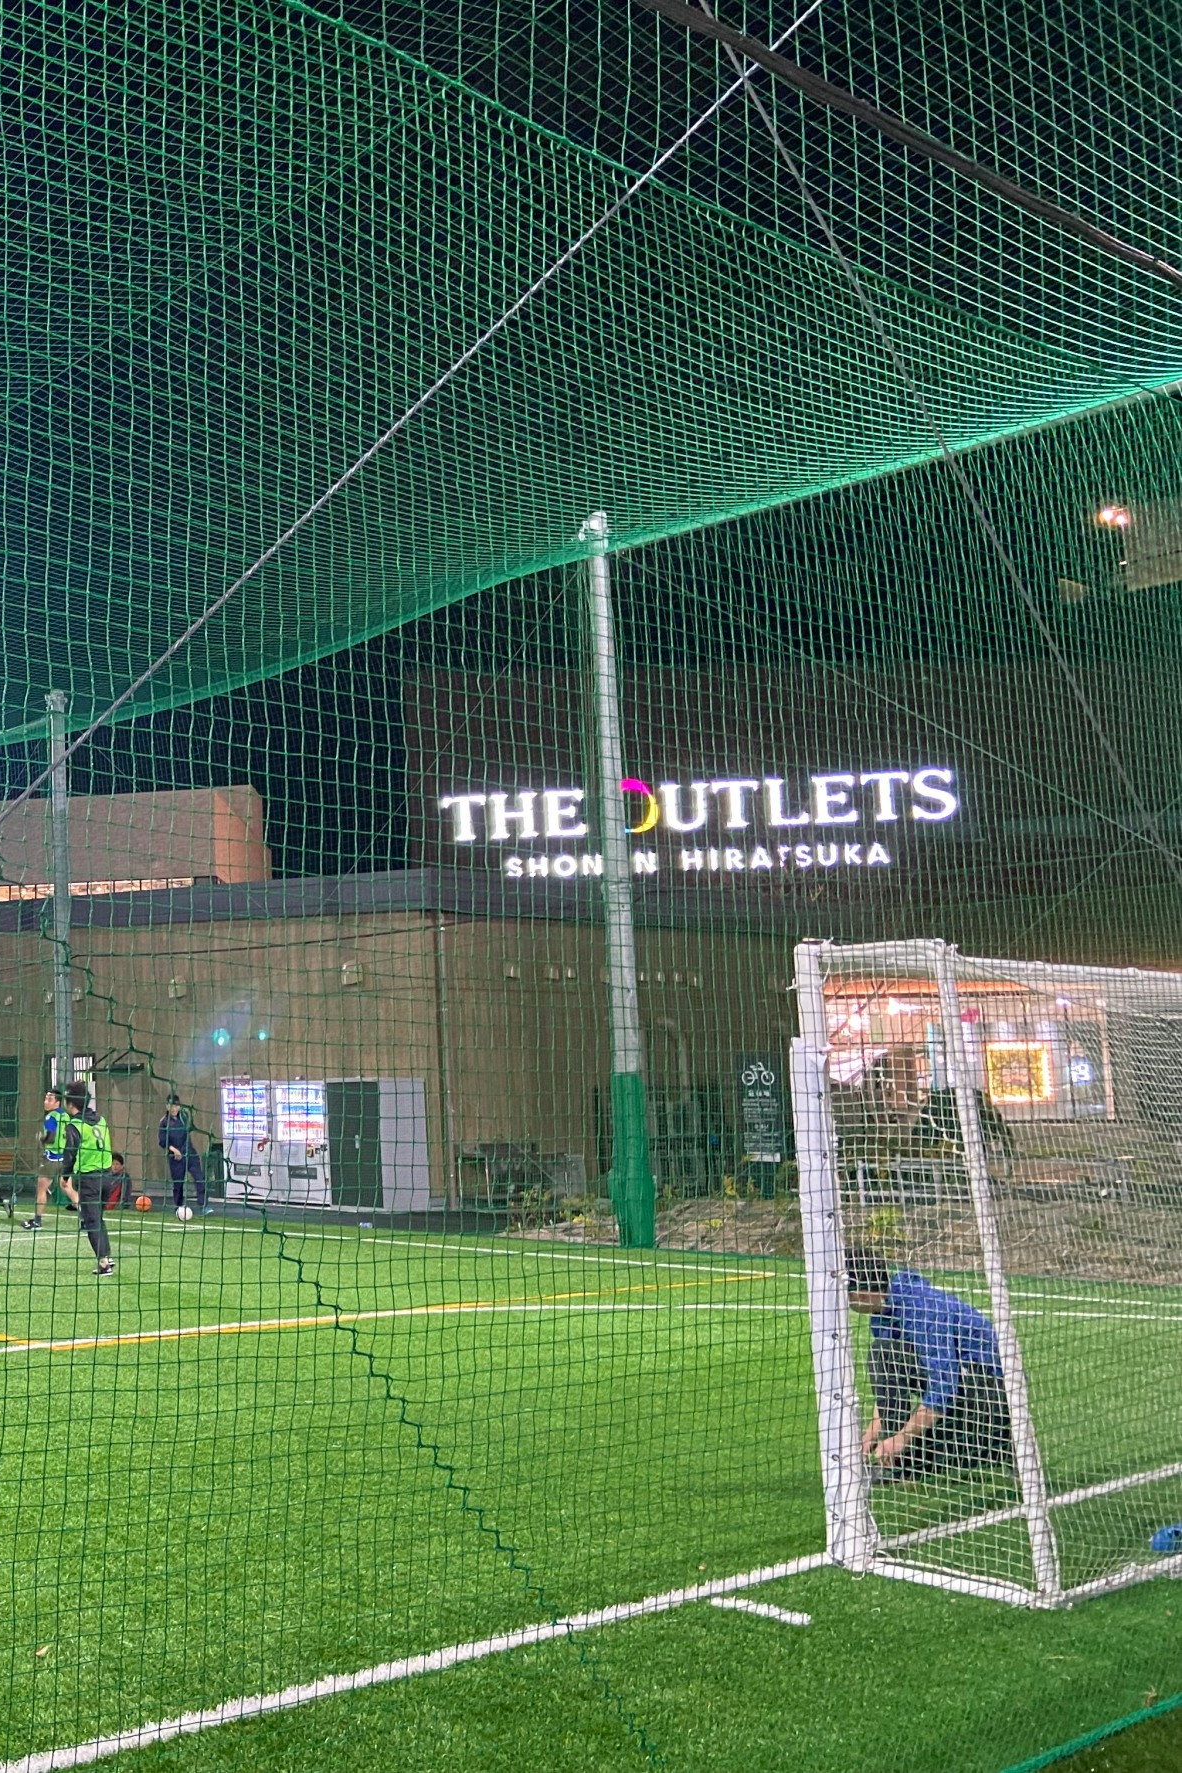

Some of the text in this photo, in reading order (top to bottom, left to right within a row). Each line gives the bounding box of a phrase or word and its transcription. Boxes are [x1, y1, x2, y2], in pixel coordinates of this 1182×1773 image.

[441, 768, 959, 842] THE OUTLETS
[506, 842, 891, 878] SHONN HIRATSUKA
